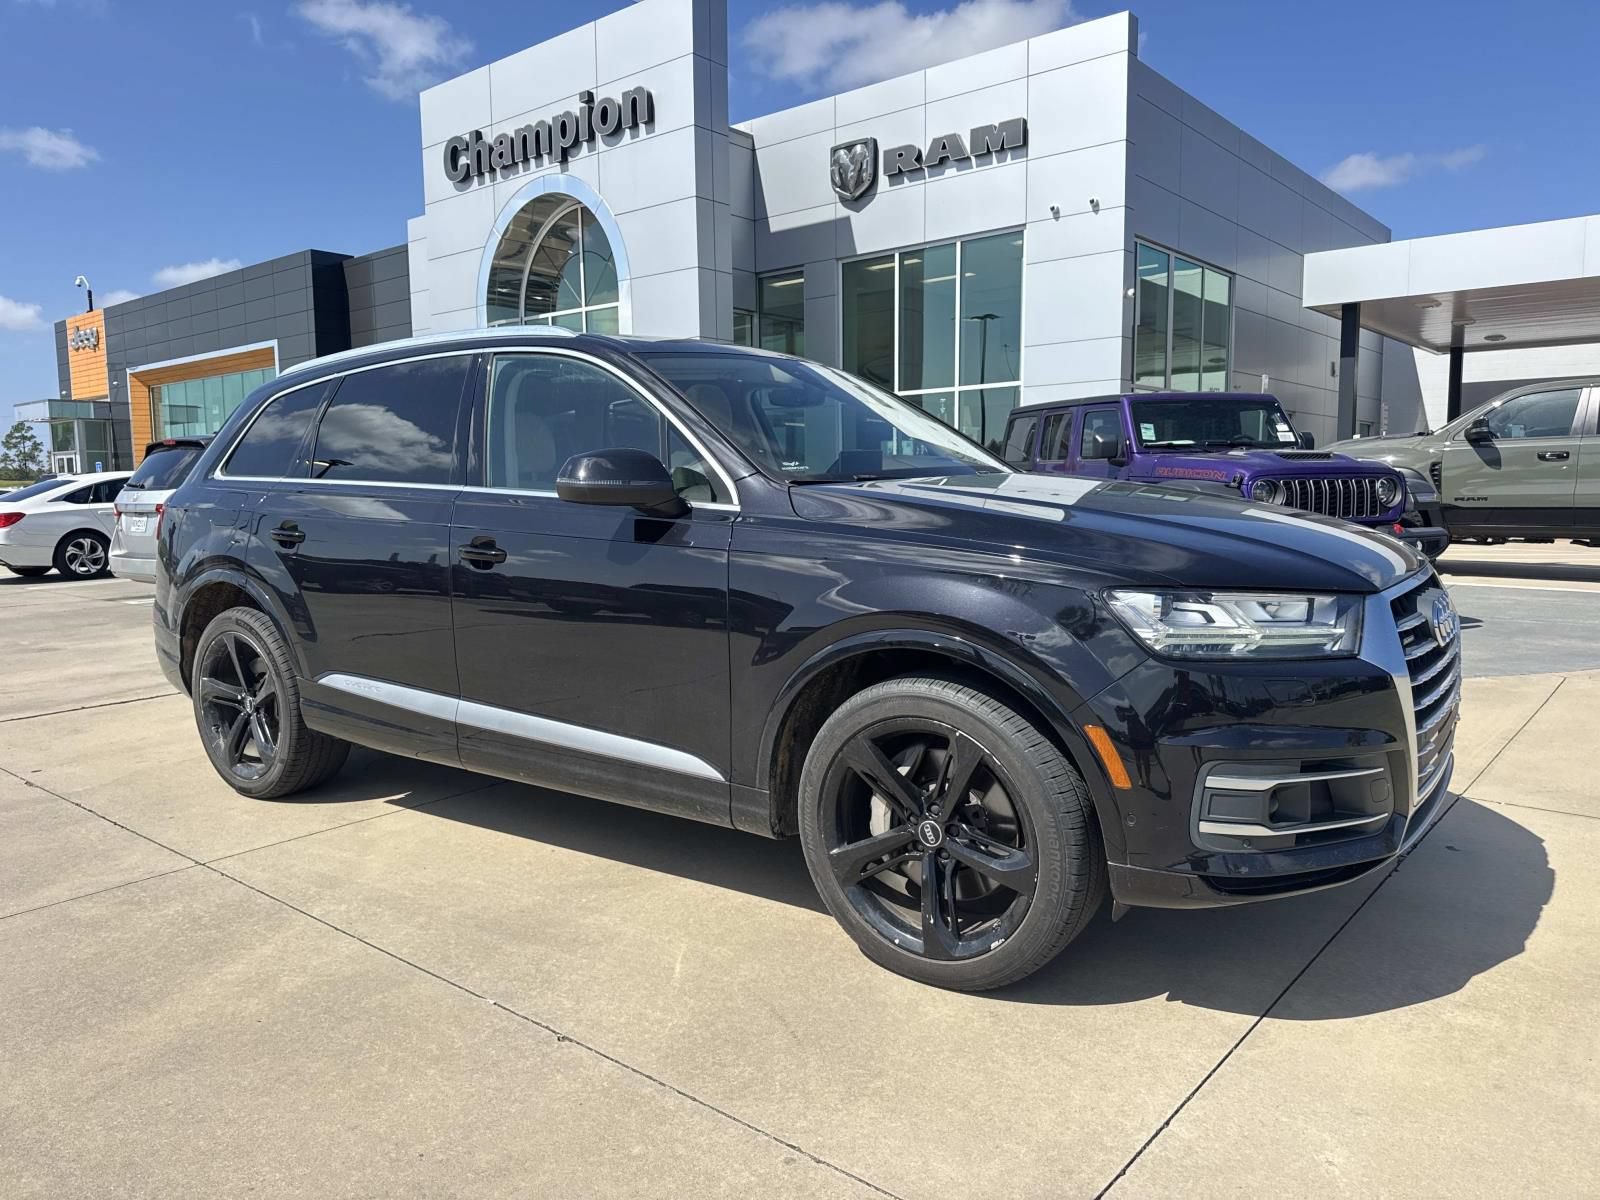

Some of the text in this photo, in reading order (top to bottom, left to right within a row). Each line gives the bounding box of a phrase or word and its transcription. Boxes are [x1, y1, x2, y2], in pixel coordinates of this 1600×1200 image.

[444, 86, 653, 182] Champion
[883, 117, 1027, 176] RAM
[71, 325, 98, 351] Jeep
[1157, 467, 1227, 480] RUBICON
